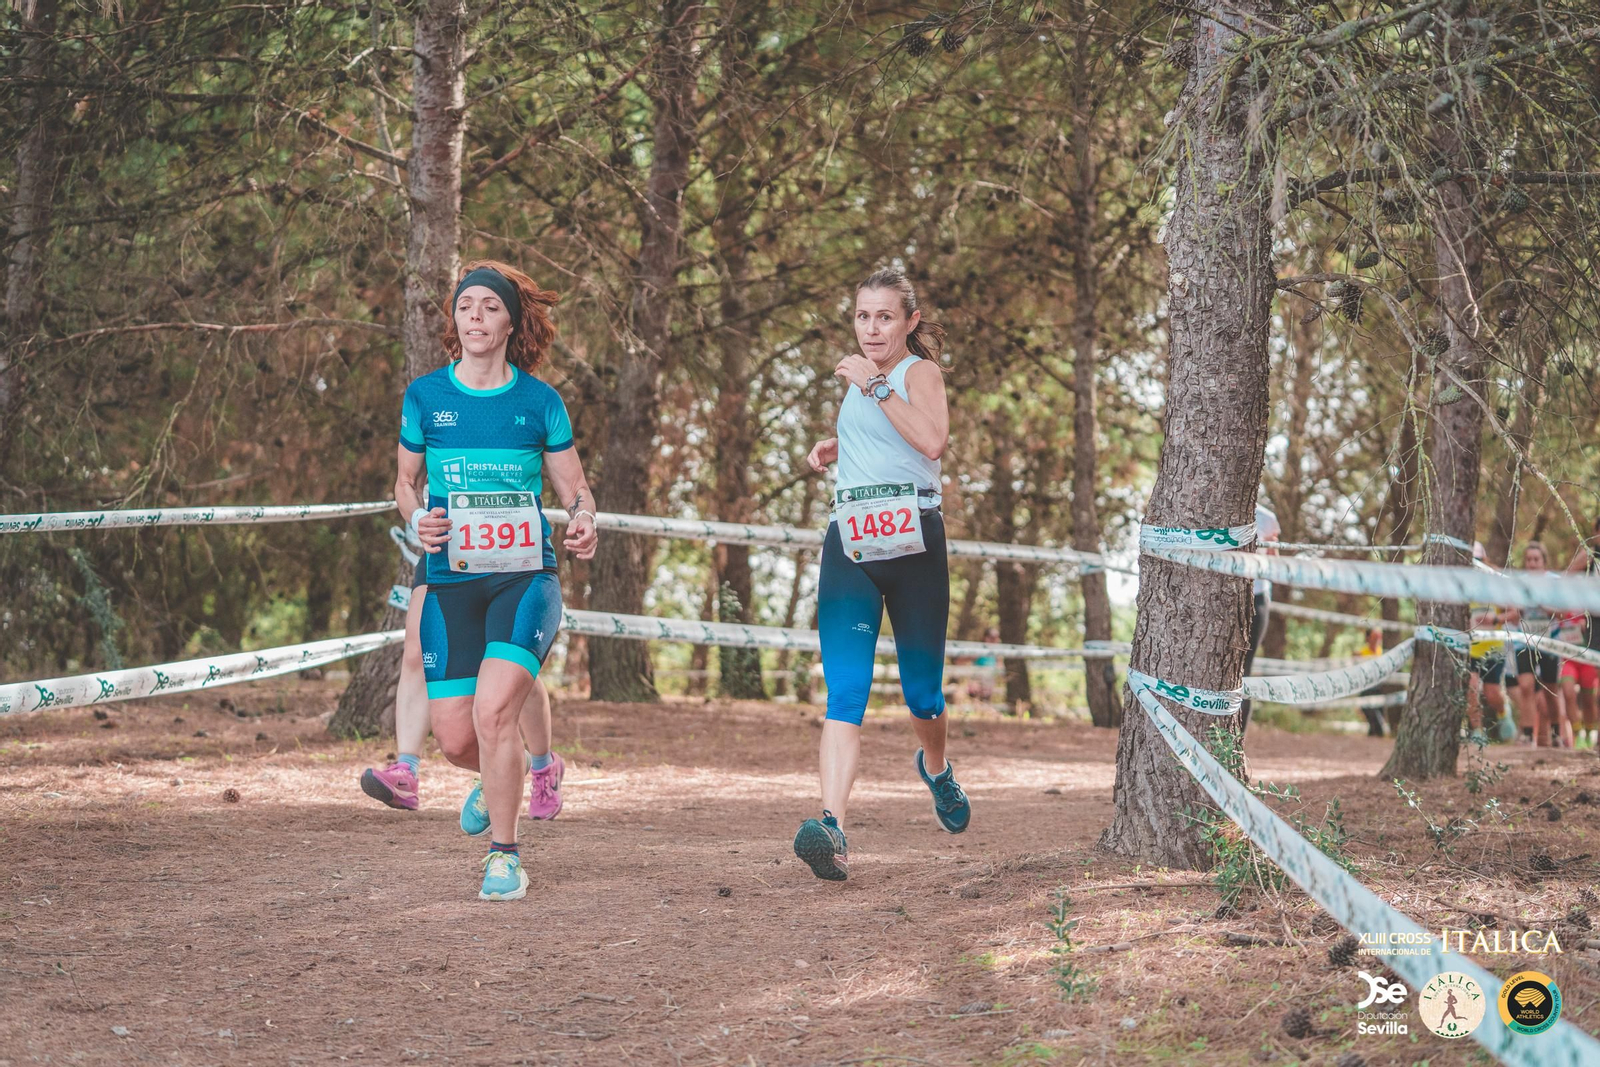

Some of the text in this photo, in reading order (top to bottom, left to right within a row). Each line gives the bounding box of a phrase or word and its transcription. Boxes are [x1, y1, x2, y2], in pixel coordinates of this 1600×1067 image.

[433, 410, 453, 422] 365
[467, 463, 523, 471] CRISTALERIA
[855, 486, 894, 498] ITÁLICA
[474, 494, 514, 506] ITÁLICA
[847, 507, 916, 541] 1482
[459, 521, 536, 551] 1391
[53, 694, 74, 706] Sevilla
[1192, 695, 1230, 710] Sevilla
